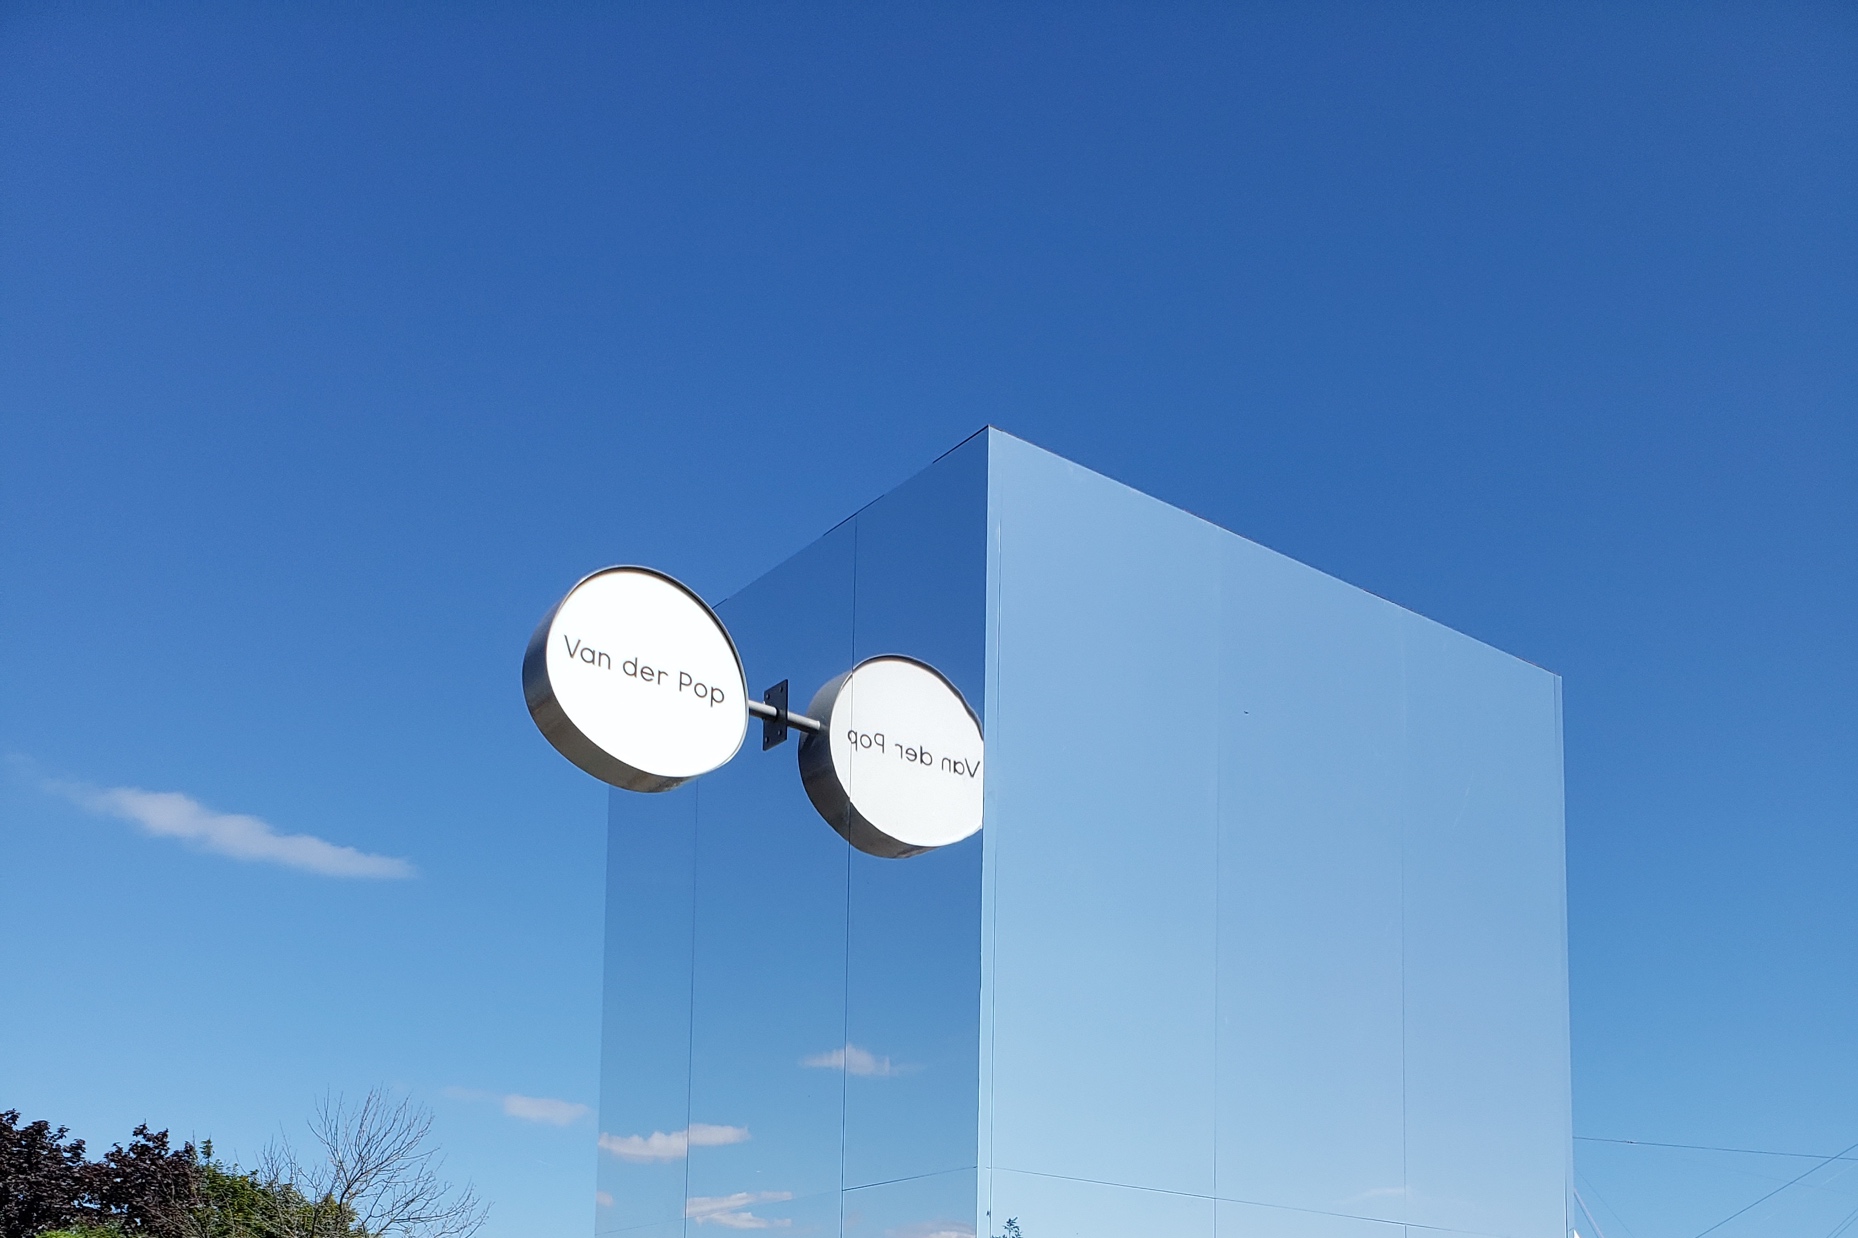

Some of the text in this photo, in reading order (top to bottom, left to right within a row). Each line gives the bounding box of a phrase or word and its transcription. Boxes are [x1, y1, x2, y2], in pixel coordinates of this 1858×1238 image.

[563, 634, 725, 708] Van der Pop
